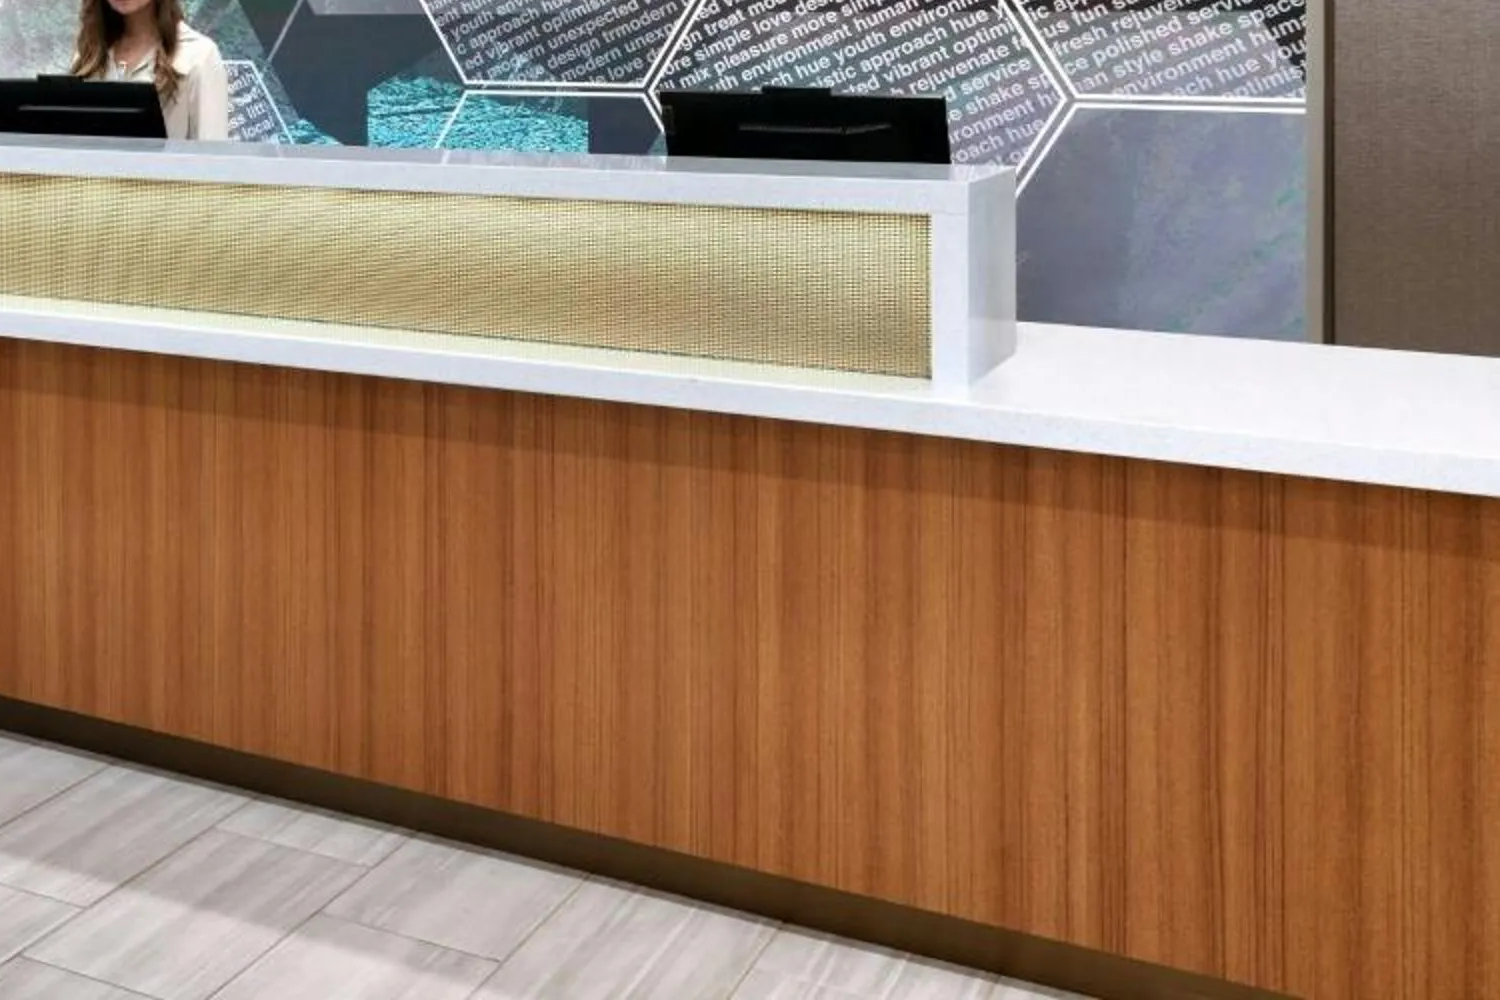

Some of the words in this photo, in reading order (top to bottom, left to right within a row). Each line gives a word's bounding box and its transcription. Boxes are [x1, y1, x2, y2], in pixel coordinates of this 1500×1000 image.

[450, 6, 493, 42] youth
[468, 3, 539, 49] approach
[693, 26, 752, 61] simple
[751, 8, 792, 35] love
[702, 5, 745, 36] treat
[1070, 2, 1108, 27] fun
[545, 35, 601, 70] design
[679, 66, 709, 88] mix
[713, 31, 789, 77] pleasure
[790, 9, 838, 38] more
[740, 20, 852, 82] environment
[794, 54, 831, 79] hue
[834, 27, 886, 66] youth
[859, 22, 947, 73] approach
[949, 8, 988, 34] hue
[1093, 12, 1182, 70] polished
[1111, 47, 1164, 79] style
[1168, 19, 1234, 57] shake
[606, 55, 645, 82] love
[883, 42, 950, 84] vibrant
[909, 42, 1010, 96] rejuvenate
[961, 56, 1031, 96] service
[1215, 56, 1260, 84] hue
[965, 81, 1024, 115] shake
